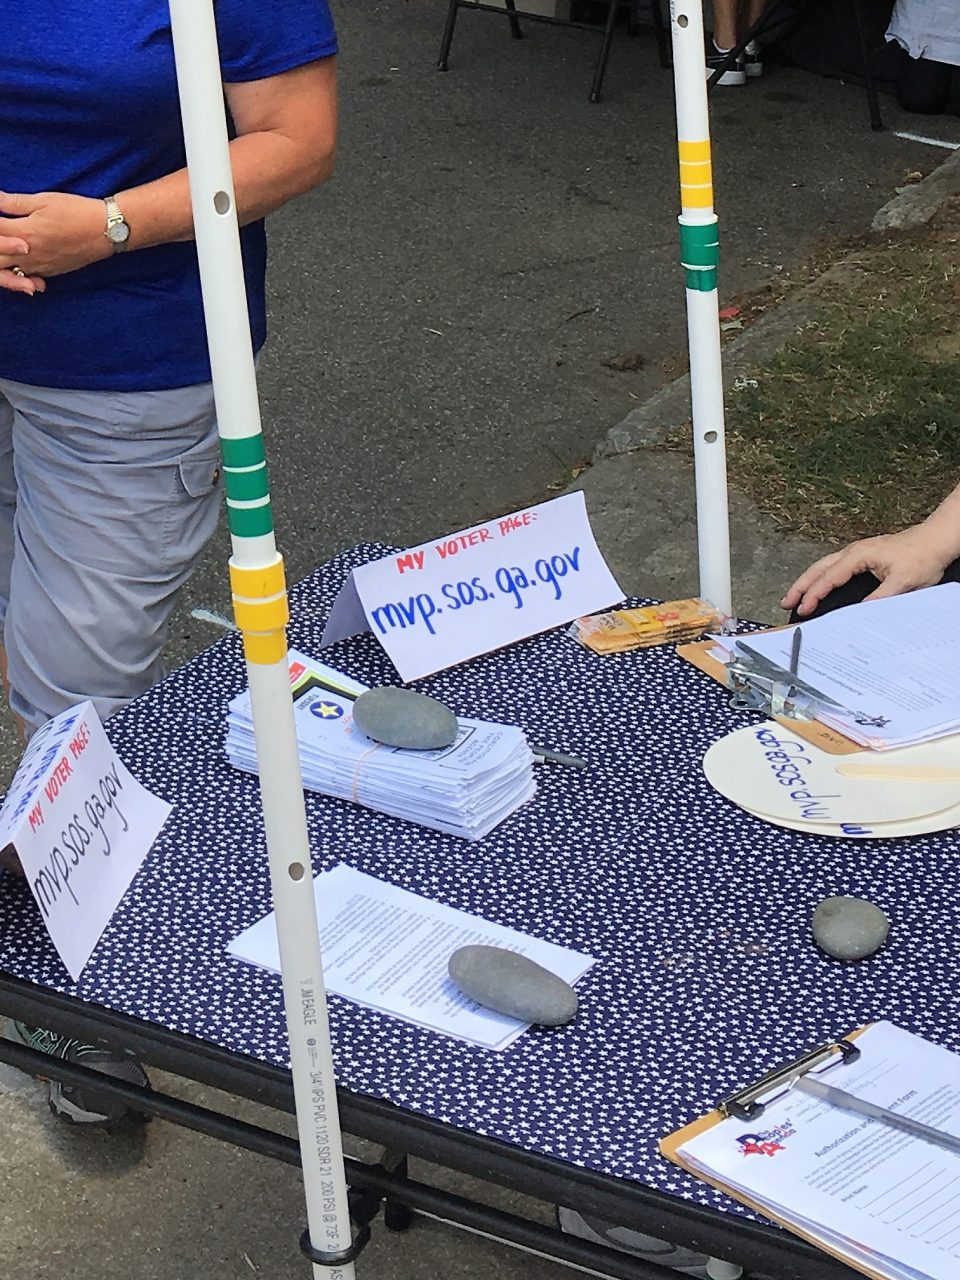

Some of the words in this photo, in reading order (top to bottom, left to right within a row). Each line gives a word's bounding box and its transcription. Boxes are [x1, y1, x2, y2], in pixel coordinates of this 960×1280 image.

[396, 551, 425, 574] MY
[435, 528, 494, 559] VOTER
[371, 546, 580, 635] mvp.sos.ga.gov
[28, 800, 45, 834] MY
[44, 757, 74, 804] VOTER
[311, 1088, 324, 1103] IPS
[312, 1104, 326, 1123] PVC
[814, 1124, 861, 1158] Authorization
[898, 1089, 918, 1105] Form
[315, 1125, 329, 1144] 1120
[317, 1146, 331, 1164] SDR
[319, 1165, 332, 1176] 21
[320, 1180, 334, 1196] 200
[322, 1197, 335, 1212] PSI
[322, 1213, 336, 1222] @
[326, 1224, 338, 1239] 73F
